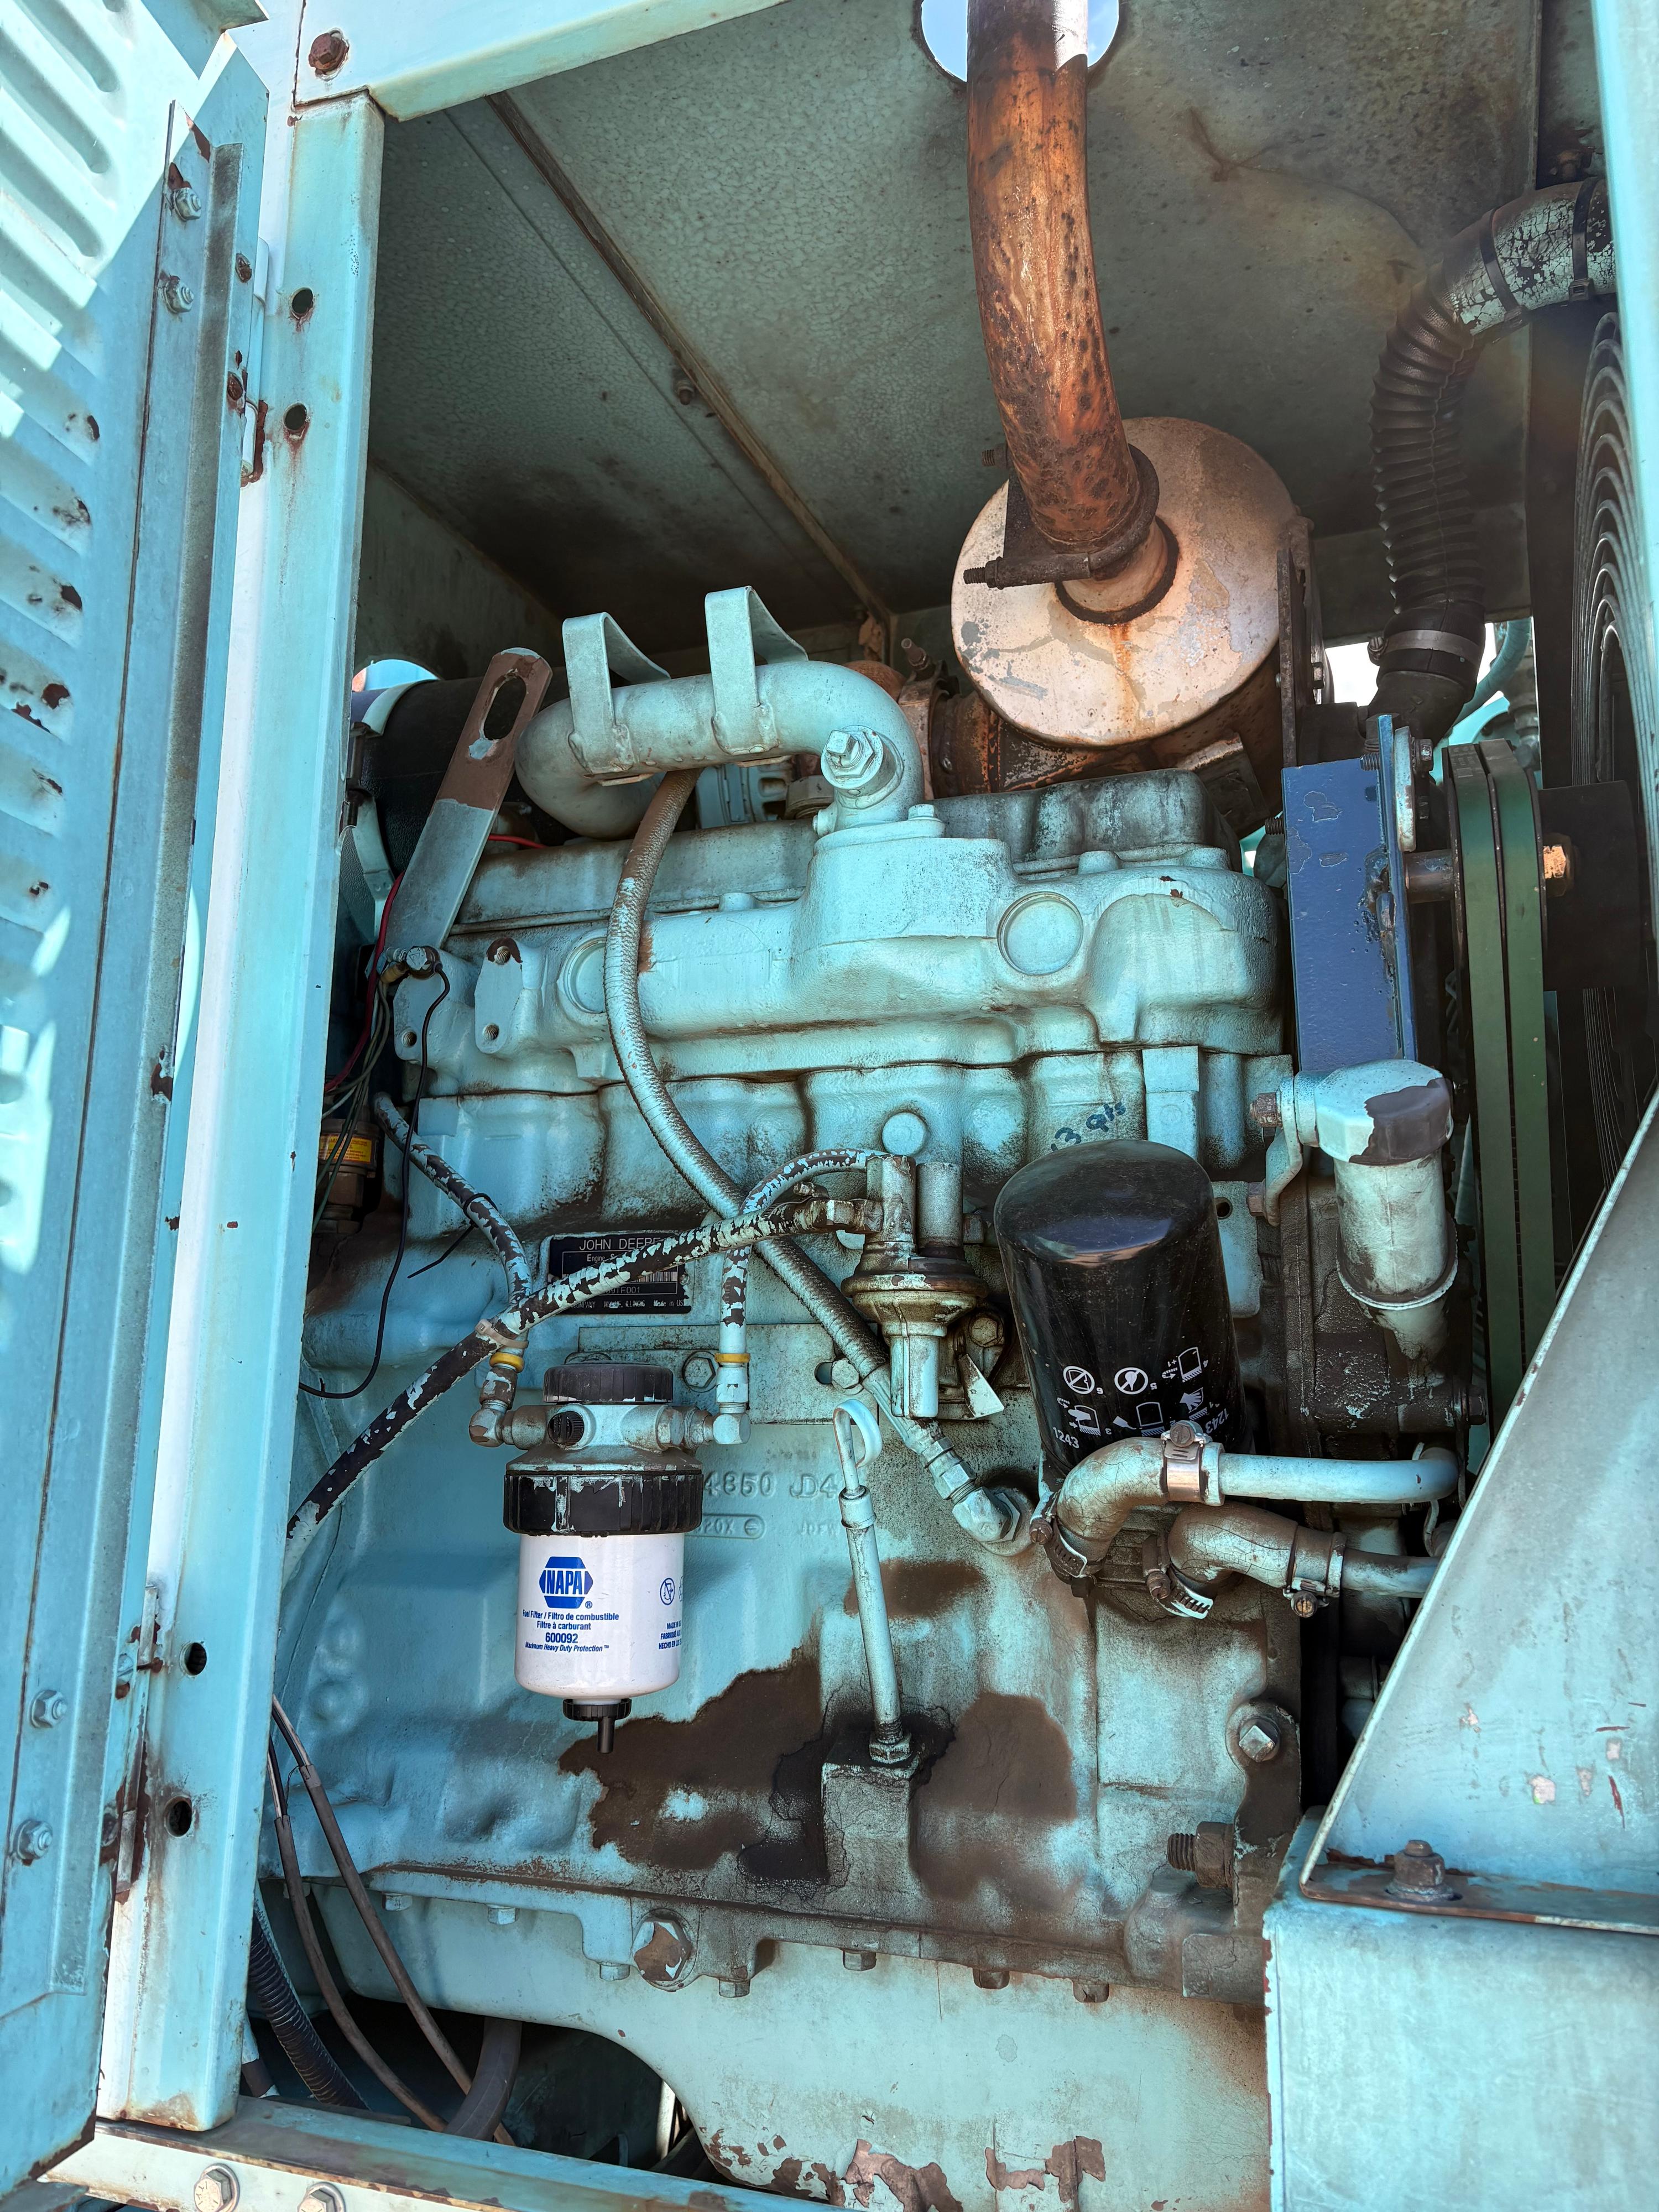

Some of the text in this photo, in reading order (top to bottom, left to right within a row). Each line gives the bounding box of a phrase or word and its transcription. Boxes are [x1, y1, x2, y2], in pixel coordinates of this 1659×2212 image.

[580, 1239, 611, 1250] JOHN
[587, 1254, 605, 1263] Engine
[1052, 1427, 1079, 1448] 1243
[546, 1570, 582, 1595] NAPA
[530, 1610, 543, 1619] Filter
[548, 1612, 565, 1620] Filtro
[537, 1620, 551, 1629] Filtre
[552, 1621, 556, 1629] à
[545, 1632, 578, 1644] 600092
[525, 1641, 543, 1650] Maximum
[544, 1644, 559, 1652] Heavy
[560, 1645, 572, 1653] Duty
[659, 1641, 671, 1650] HECHO
